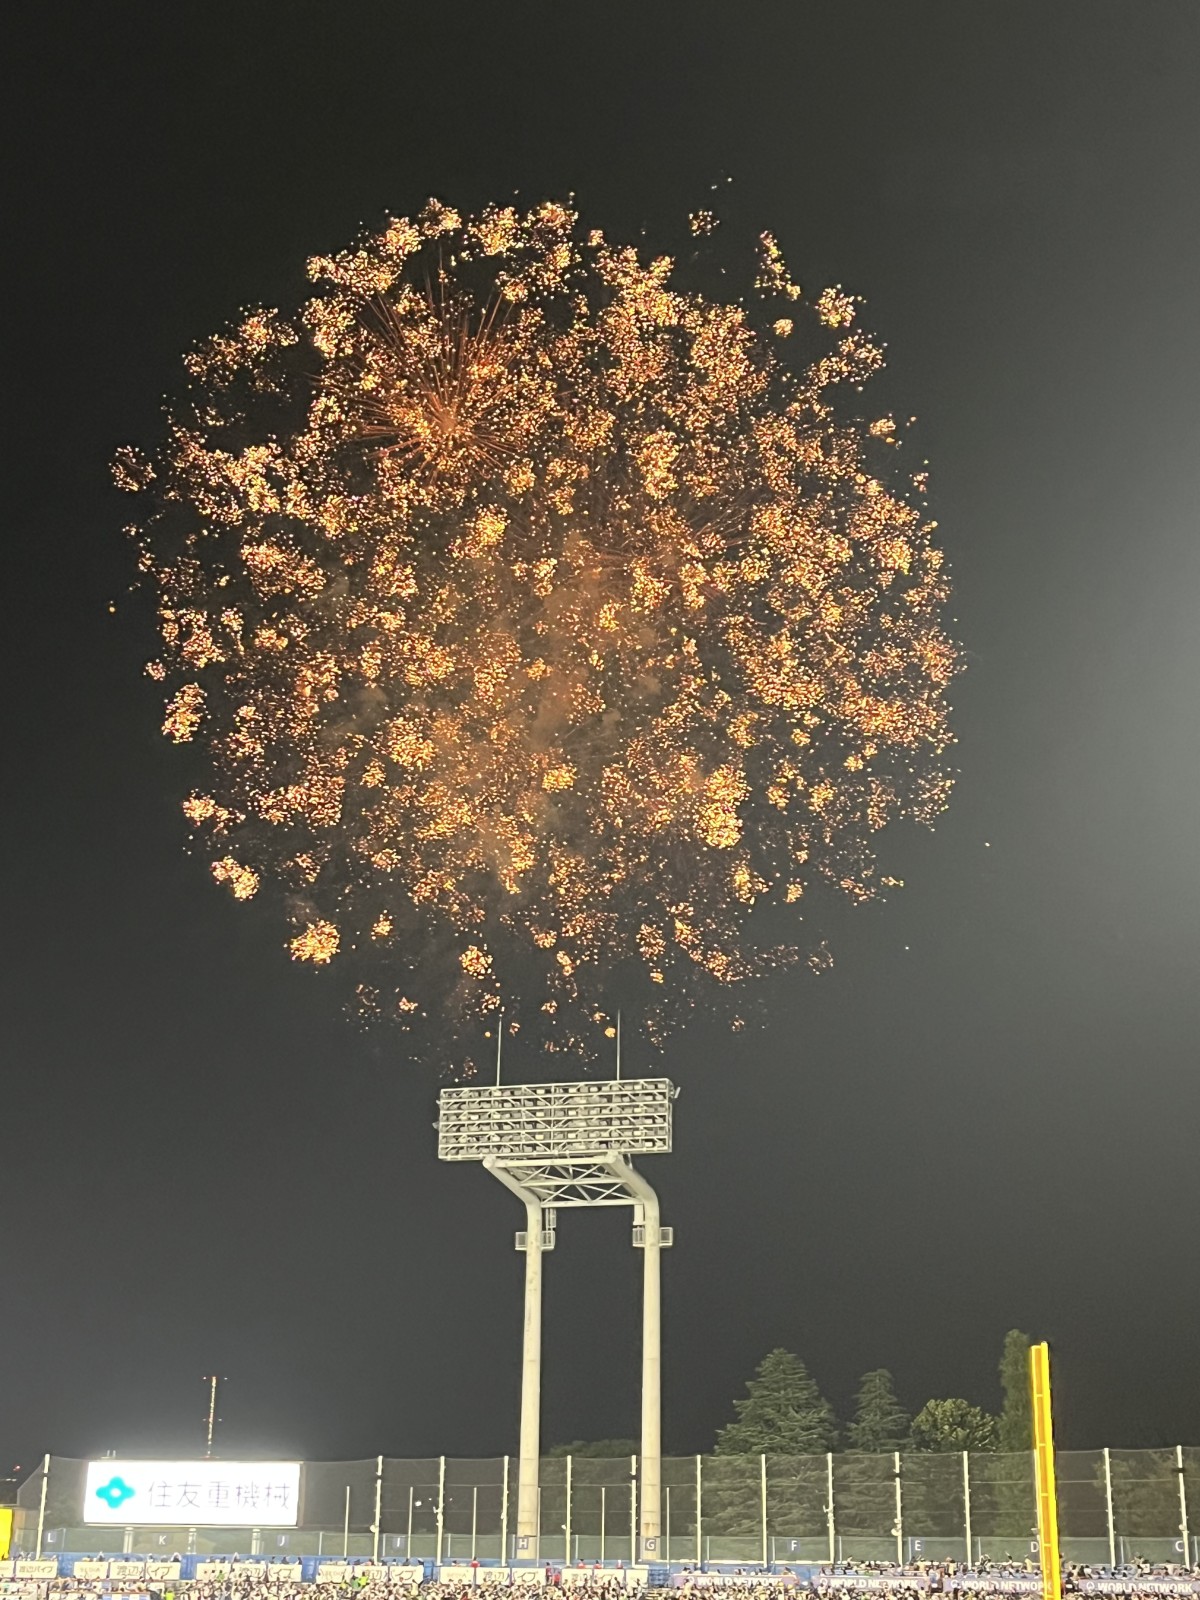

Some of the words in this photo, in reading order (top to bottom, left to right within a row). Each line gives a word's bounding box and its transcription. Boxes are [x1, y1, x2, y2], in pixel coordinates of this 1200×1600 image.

[148, 1481, 291, 1510] 住友重機械
[48, 1533, 53, 1542] L
[159, 1535, 166, 1545] K
[280, 1535, 285, 1545] J
[519, 1538, 528, 1548] H
[646, 1539, 655, 1549] G
[791, 1540, 798, 1550] F
[915, 1541, 922, 1551] E
[1031, 1541, 1039, 1552] D
[1175, 1541, 1184, 1552] C
[831, 1578, 867, 1588] WORLD
[962, 1580, 999, 1590] WORLD
[1098, 1583, 1136, 1592] WORLD
[1138, 1583, 1192, 1593] NETWORK
